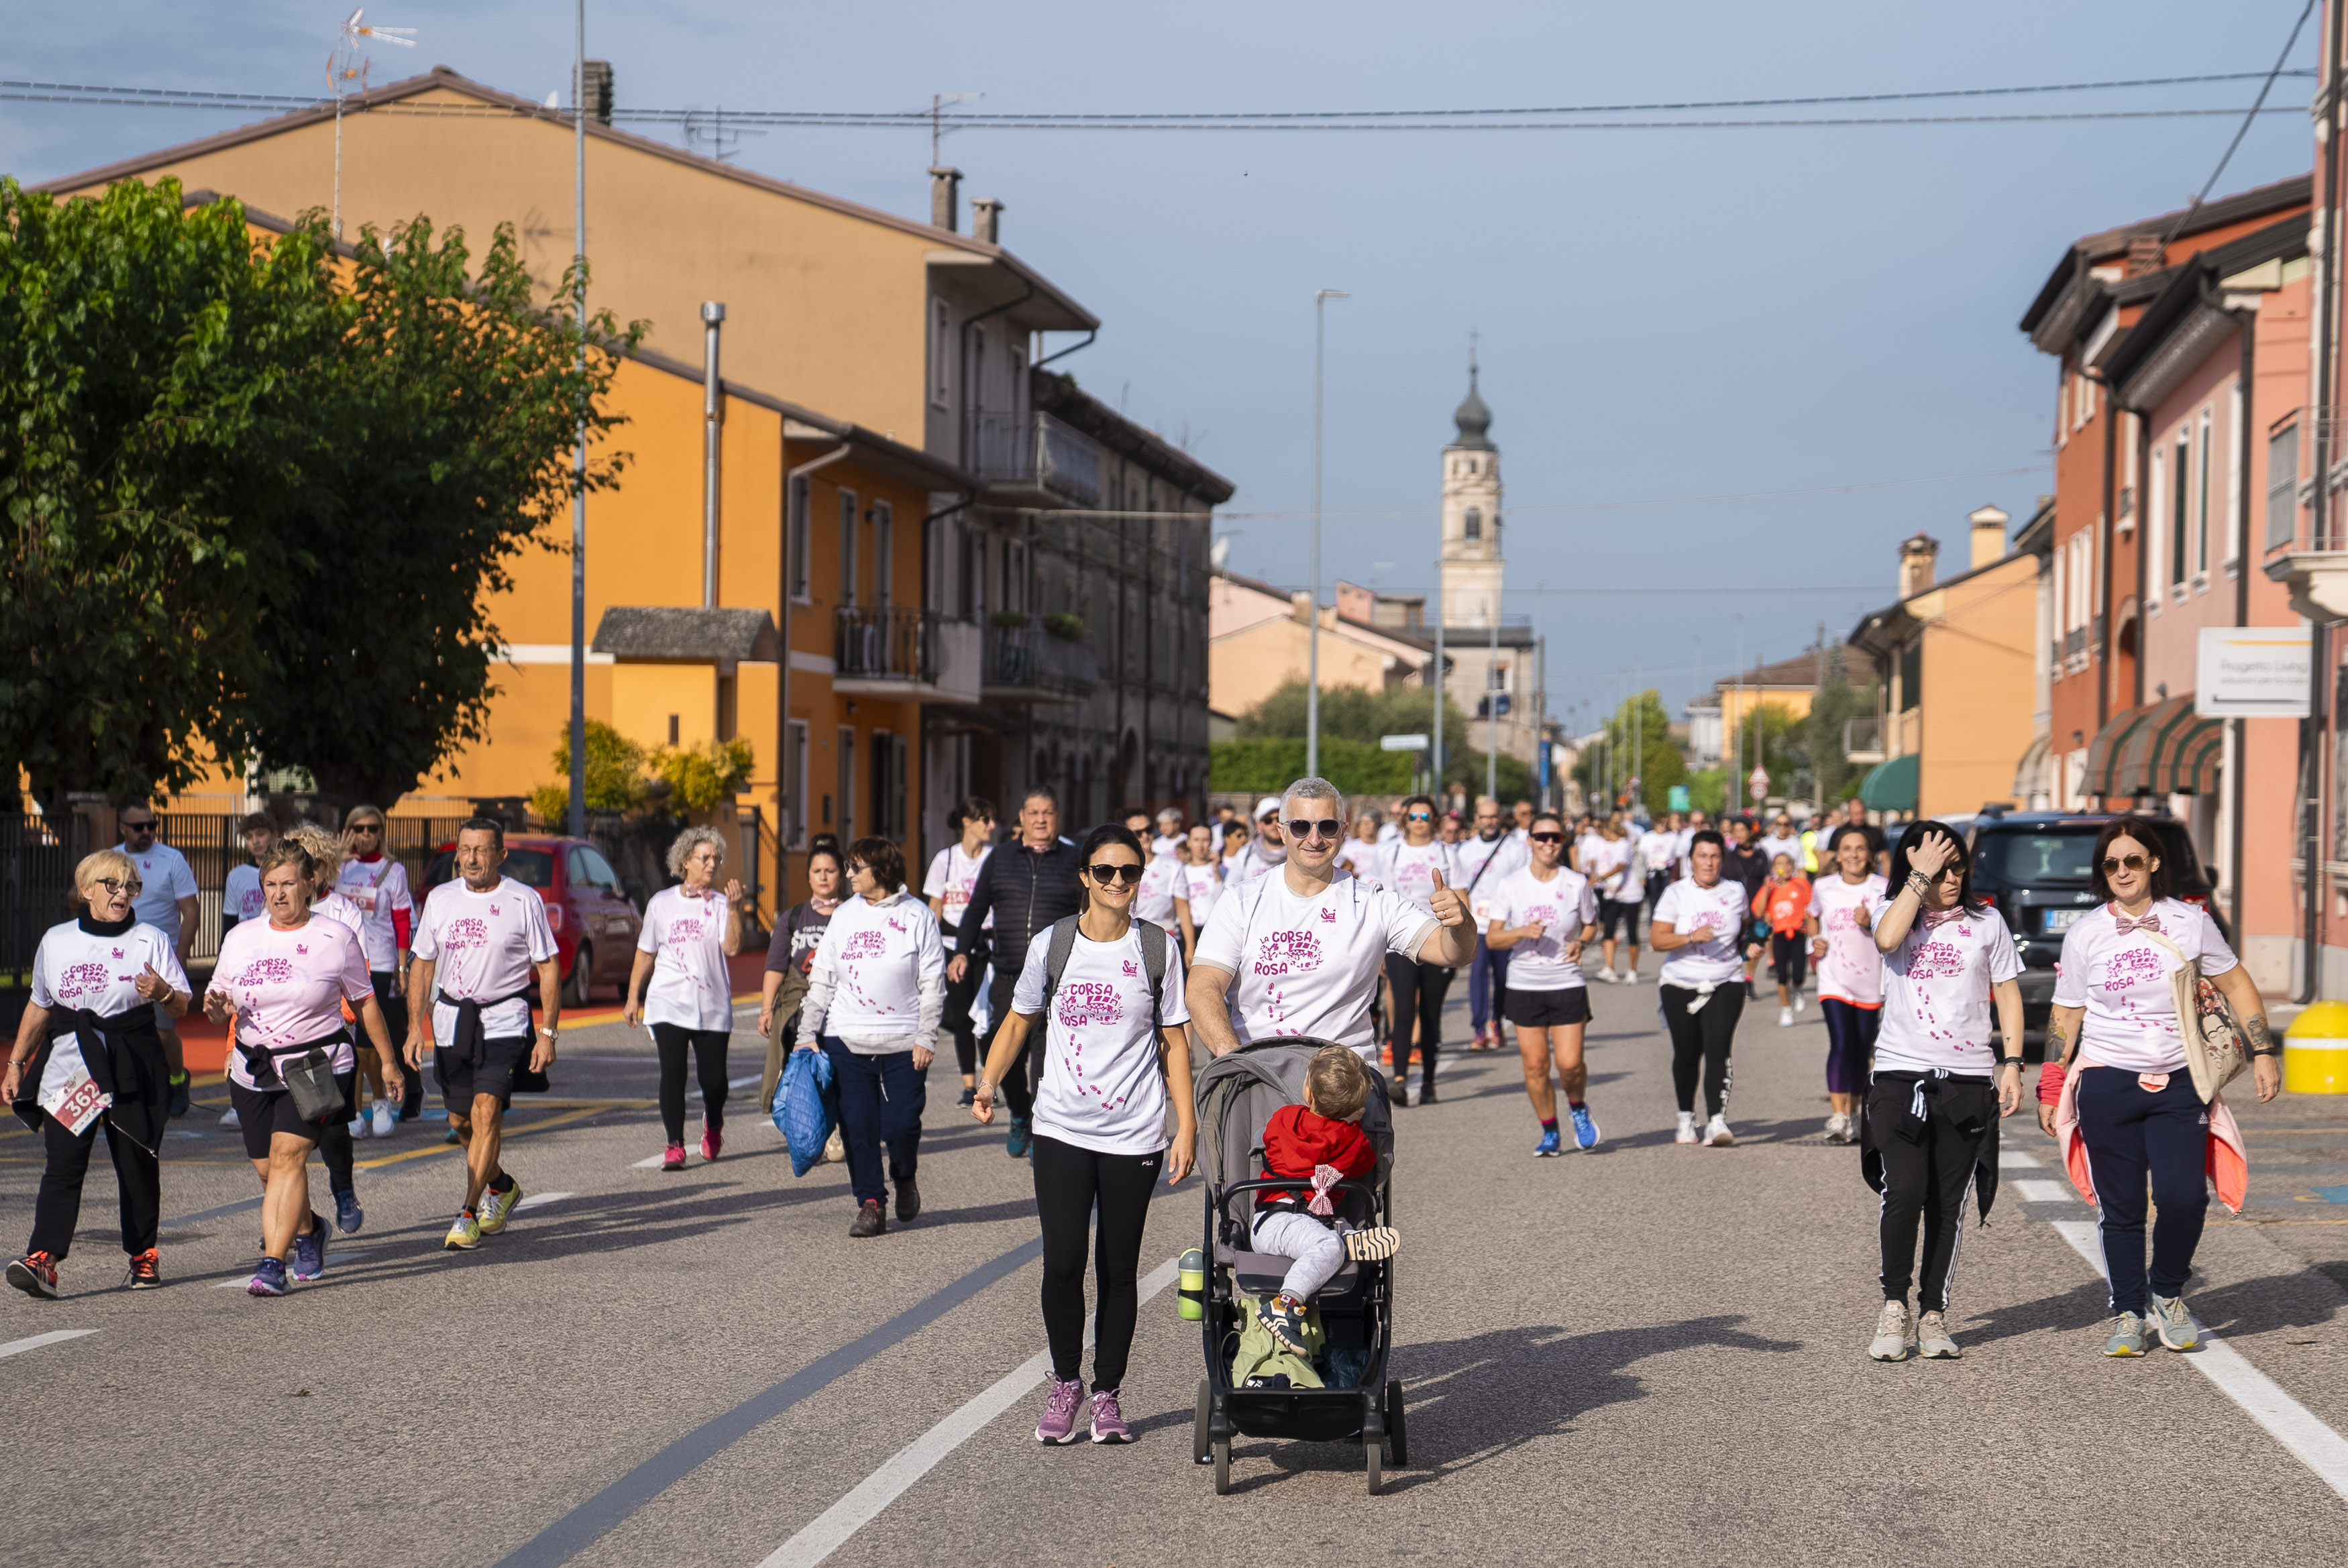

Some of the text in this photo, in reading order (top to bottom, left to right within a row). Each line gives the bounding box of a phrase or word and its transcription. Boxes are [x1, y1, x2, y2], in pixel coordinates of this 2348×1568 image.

[456, 918, 483, 928] CORSA
[854, 931, 882, 940] CORSA
[1272, 930, 1312, 943] CORSA
[445, 940, 466, 950] ROSA
[1919, 942, 1954, 952] CORSA
[841, 952, 863, 960] ROSA
[2115, 948, 2151, 962] CORSA
[70, 963, 103, 974] CORSA
[256, 958, 287, 967] CORSA
[1255, 962, 1288, 975] ROSA
[1907, 967, 1933, 979] ROSA
[238, 977, 263, 987] ROSA
[2105, 976, 2135, 991] ROSA
[58, 986, 83, 999] ROSA
[1071, 983, 1113, 996] CORSA
[1059, 1011, 1087, 1027] ROSA
[64, 1084, 100, 1117] 362
